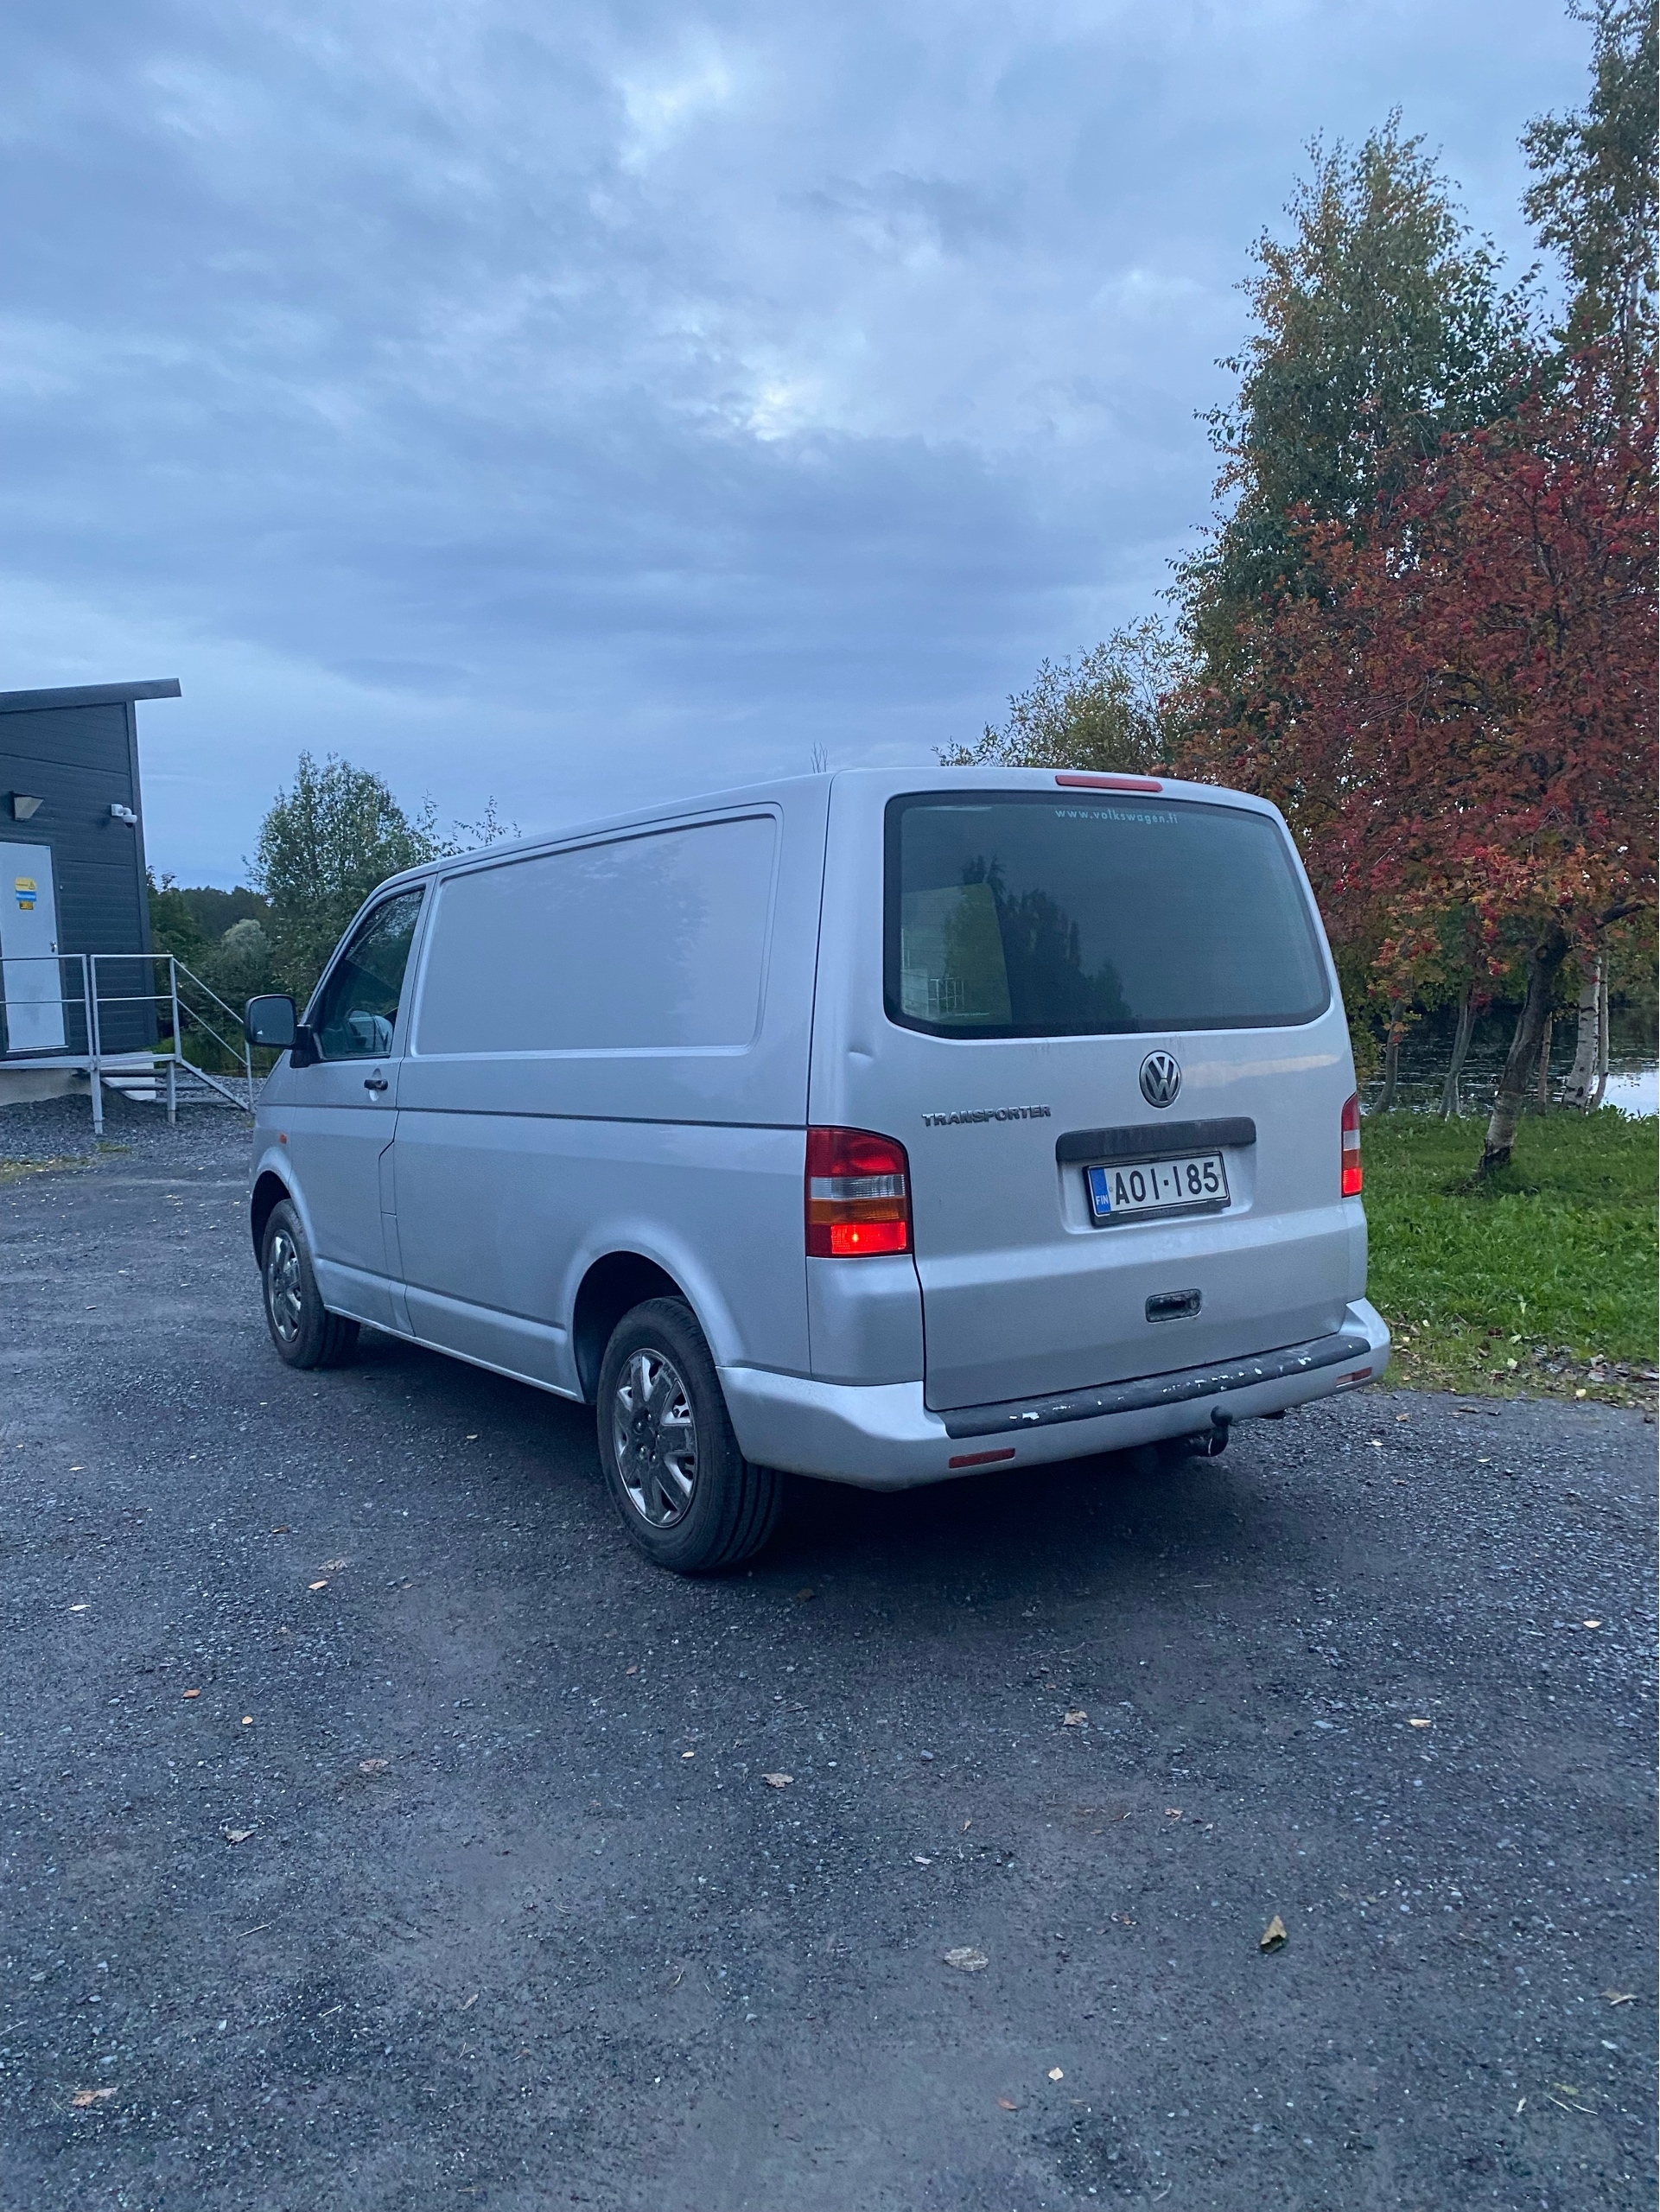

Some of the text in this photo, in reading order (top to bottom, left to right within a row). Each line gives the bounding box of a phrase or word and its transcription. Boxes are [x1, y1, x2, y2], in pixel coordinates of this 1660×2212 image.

[1055, 809, 1179, 824] www.volkswagen.fi
[1141, 1051, 1180, 1108] VW
[922, 1104, 1051, 1127] TRANSPORTER
[1096, 1194, 1109, 1205] FIN
